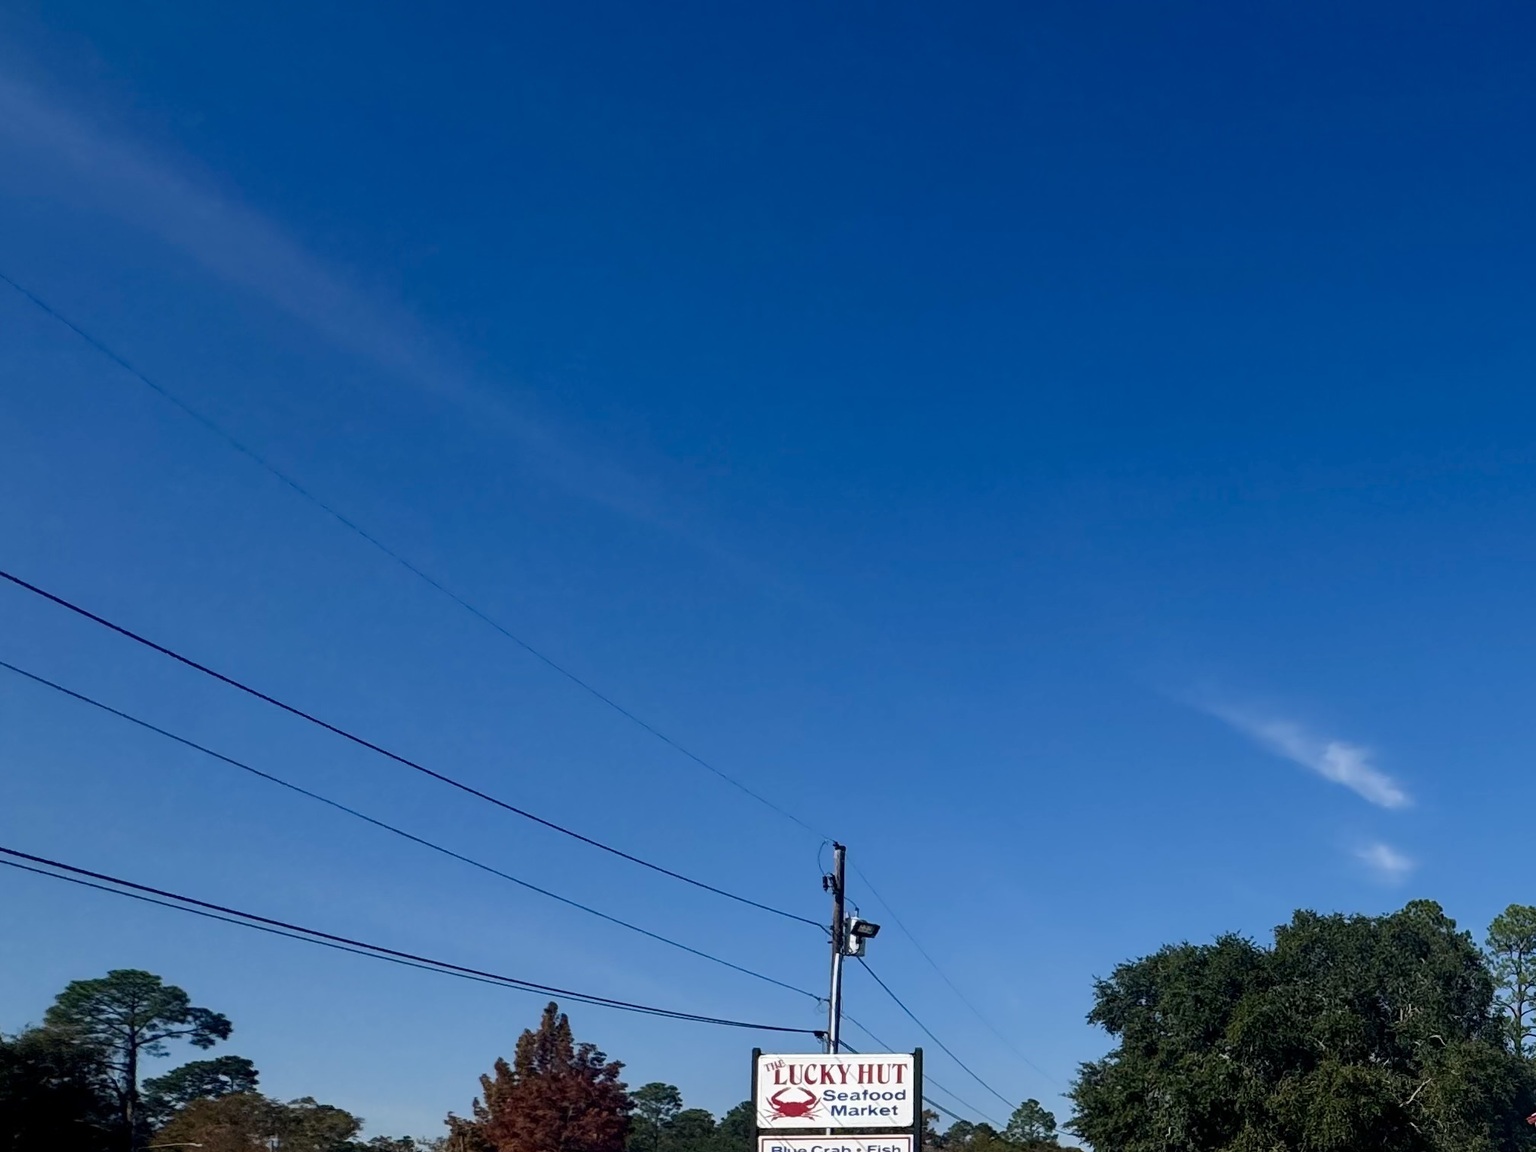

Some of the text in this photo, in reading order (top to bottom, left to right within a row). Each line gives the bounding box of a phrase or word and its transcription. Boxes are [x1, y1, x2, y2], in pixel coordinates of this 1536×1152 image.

[764, 1059, 787, 1072] THE
[774, 1063, 909, 1085] LUCKY HUT
[822, 1089, 906, 1102] Seafood
[830, 1104, 899, 1117] Market
